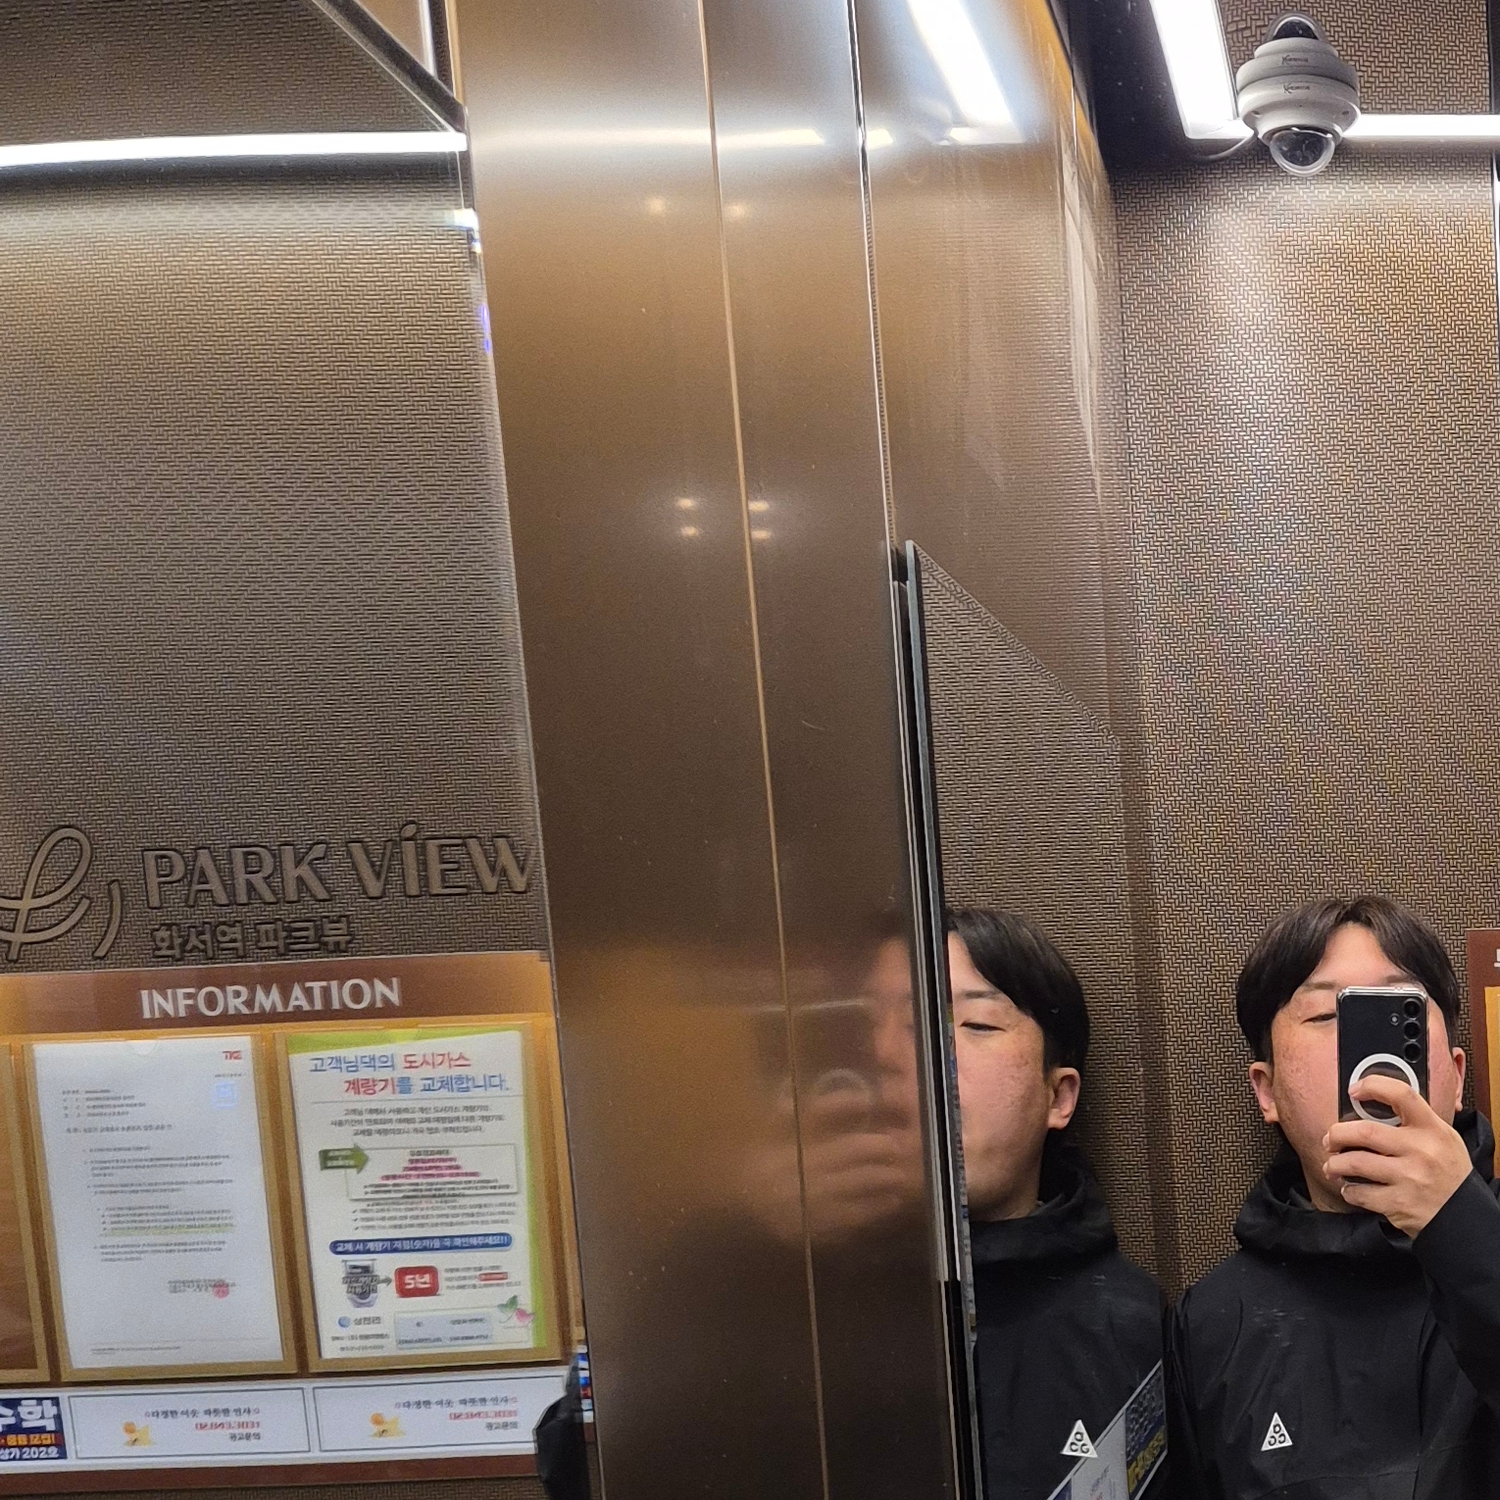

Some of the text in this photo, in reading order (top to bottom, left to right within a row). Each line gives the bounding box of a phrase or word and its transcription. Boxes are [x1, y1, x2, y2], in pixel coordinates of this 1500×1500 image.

[142, 842, 332, 910] PARK
[152, 914, 355, 959] 화서역 파크뷰
[140, 977, 401, 1020] INFORMATION
[309, 1051, 472, 1074] 고객님댁의 도시가스
[343, 1073, 511, 1096] 계량기를 교체합니다.
[404, 1273, 432, 1289] 5년
